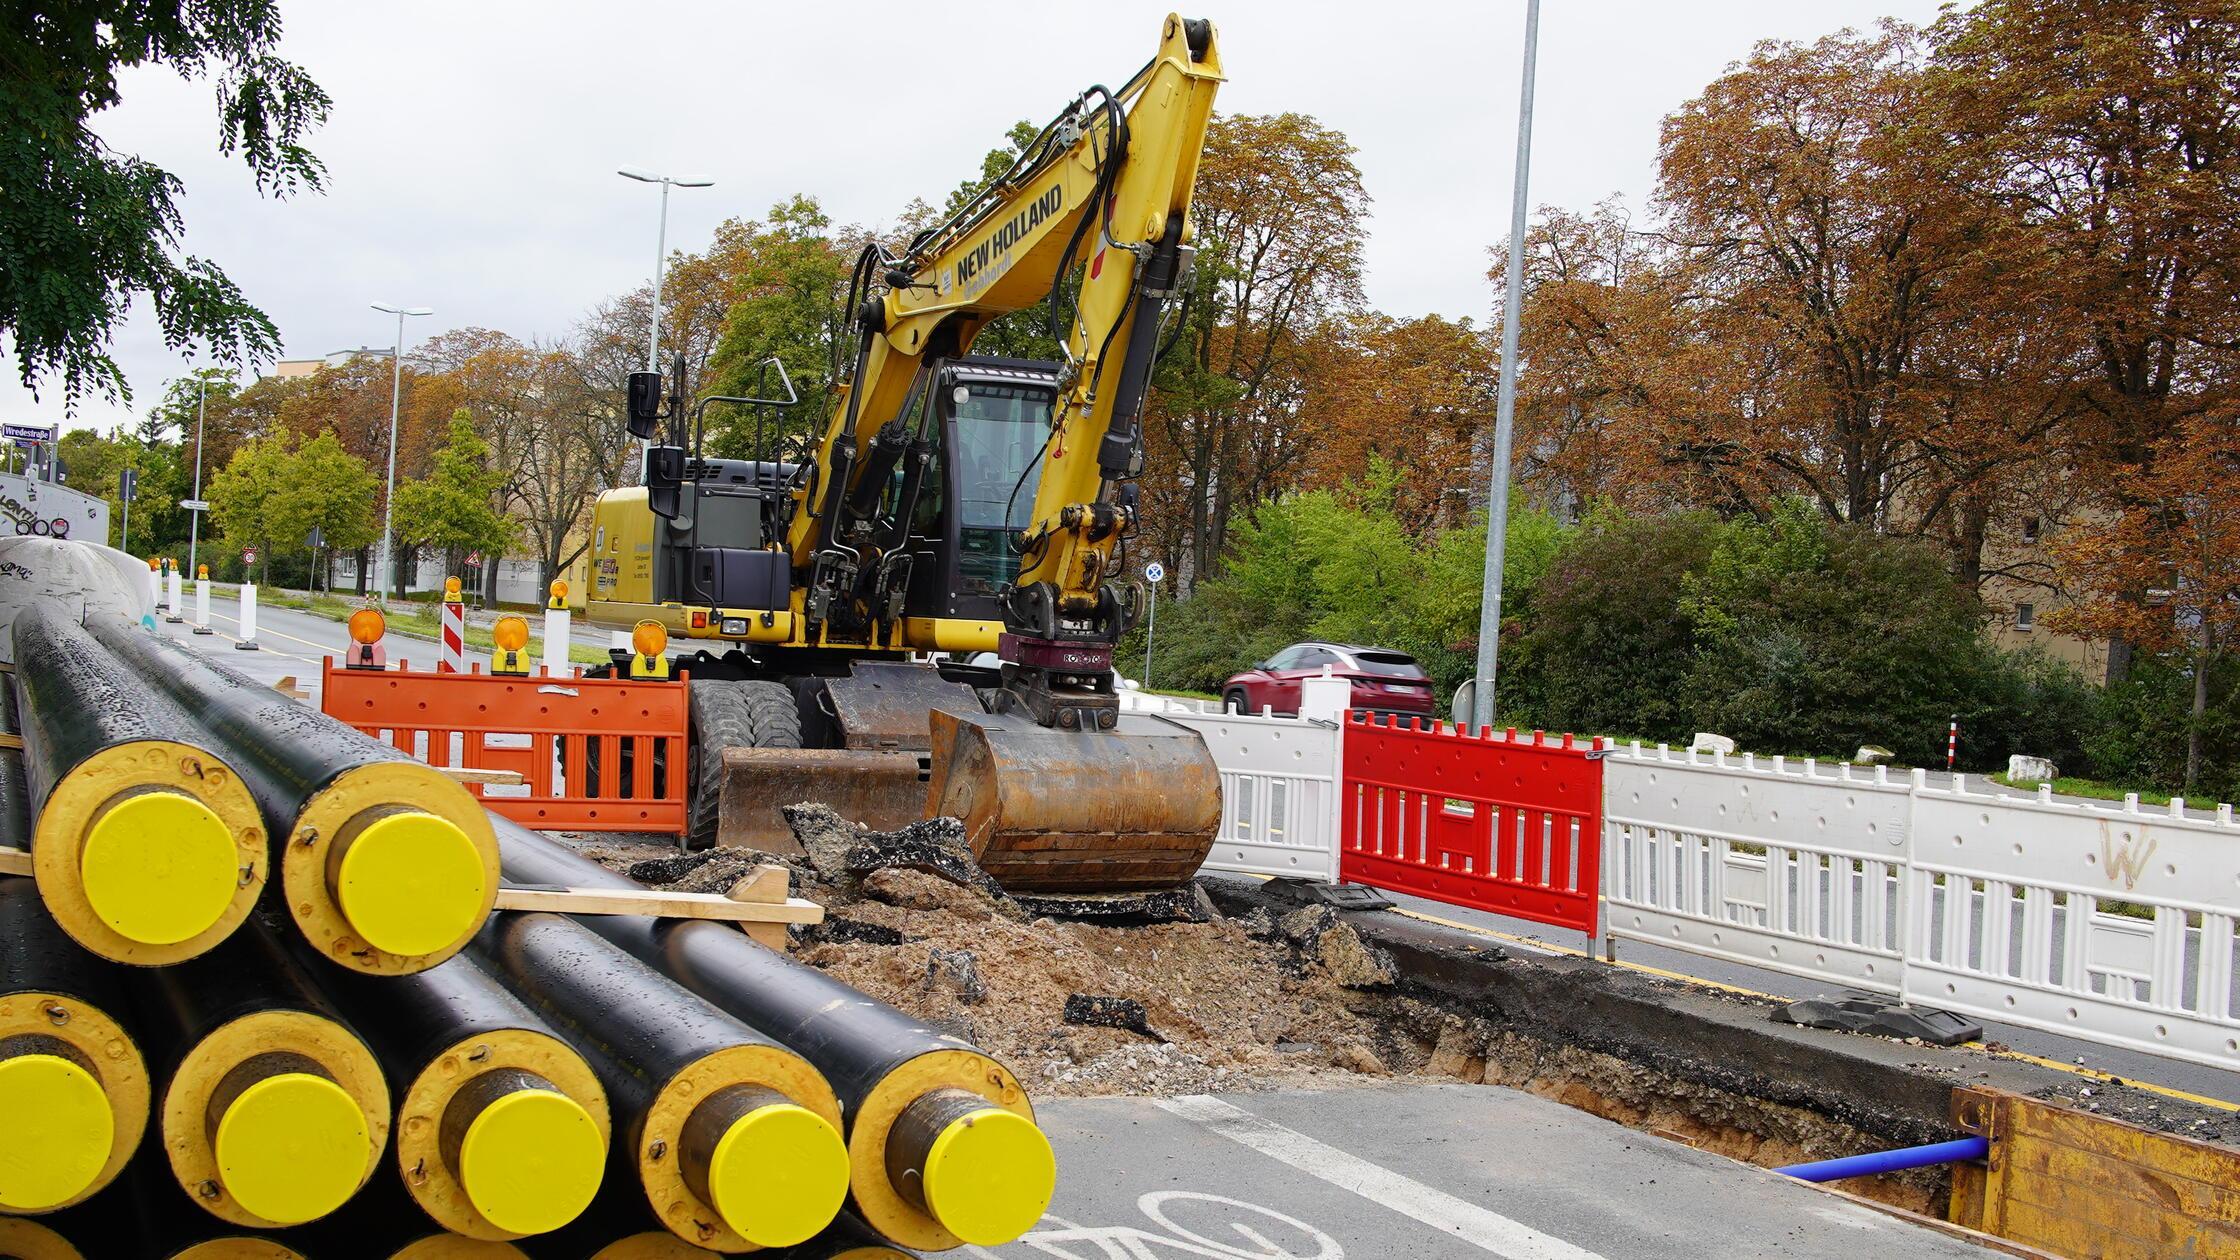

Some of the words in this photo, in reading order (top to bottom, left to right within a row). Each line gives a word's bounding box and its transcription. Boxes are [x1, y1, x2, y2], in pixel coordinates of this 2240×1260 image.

[958, 239, 989, 286] NEW
[993, 184, 1061, 259] HOLLAND
[5, 426, 48, 439] Wredestraße
